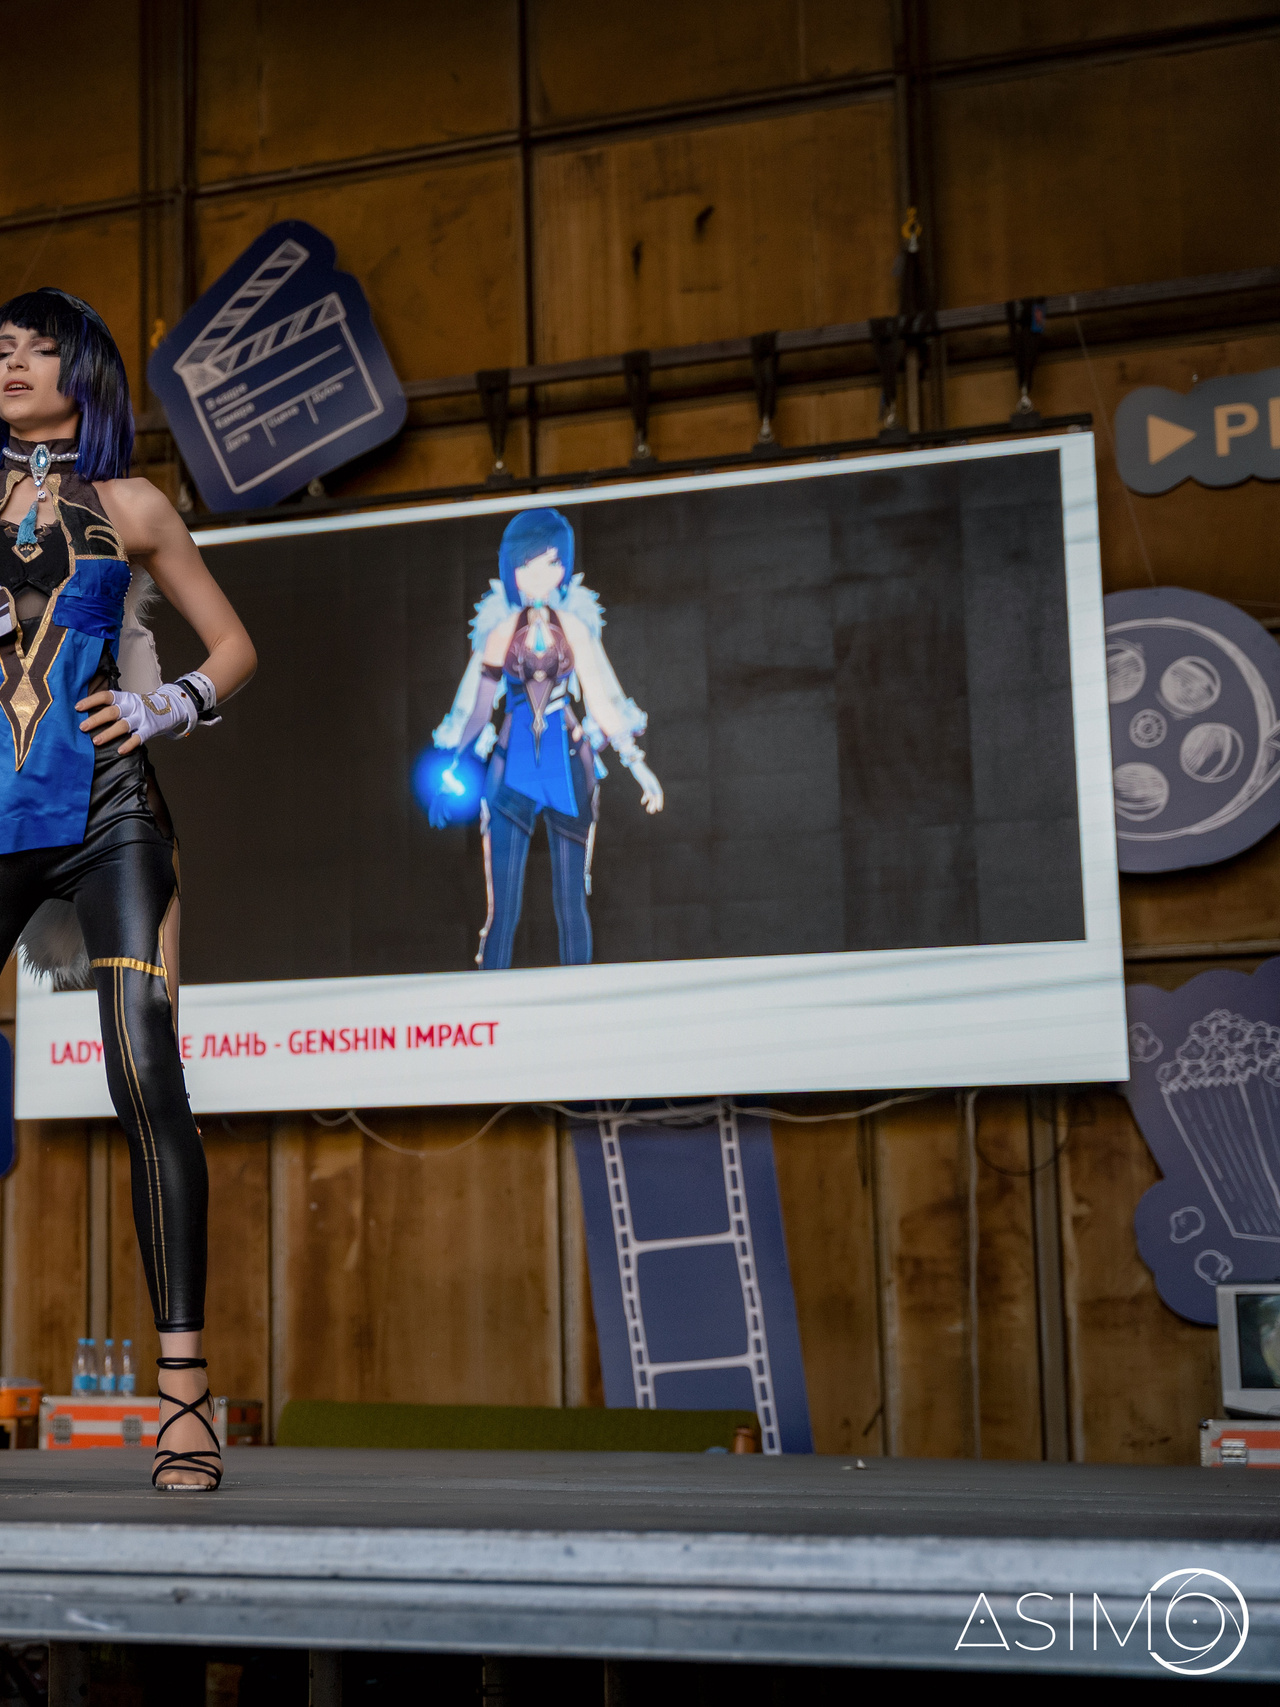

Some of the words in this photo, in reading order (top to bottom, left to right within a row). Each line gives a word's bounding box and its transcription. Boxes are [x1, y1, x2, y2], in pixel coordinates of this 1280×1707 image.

[51, 1041, 103, 1064] LADY
[201, 1032, 267, 1058] ЛАНЬ
[288, 1026, 396, 1054] GENSHIN
[406, 1022, 499, 1048] IMPACT
